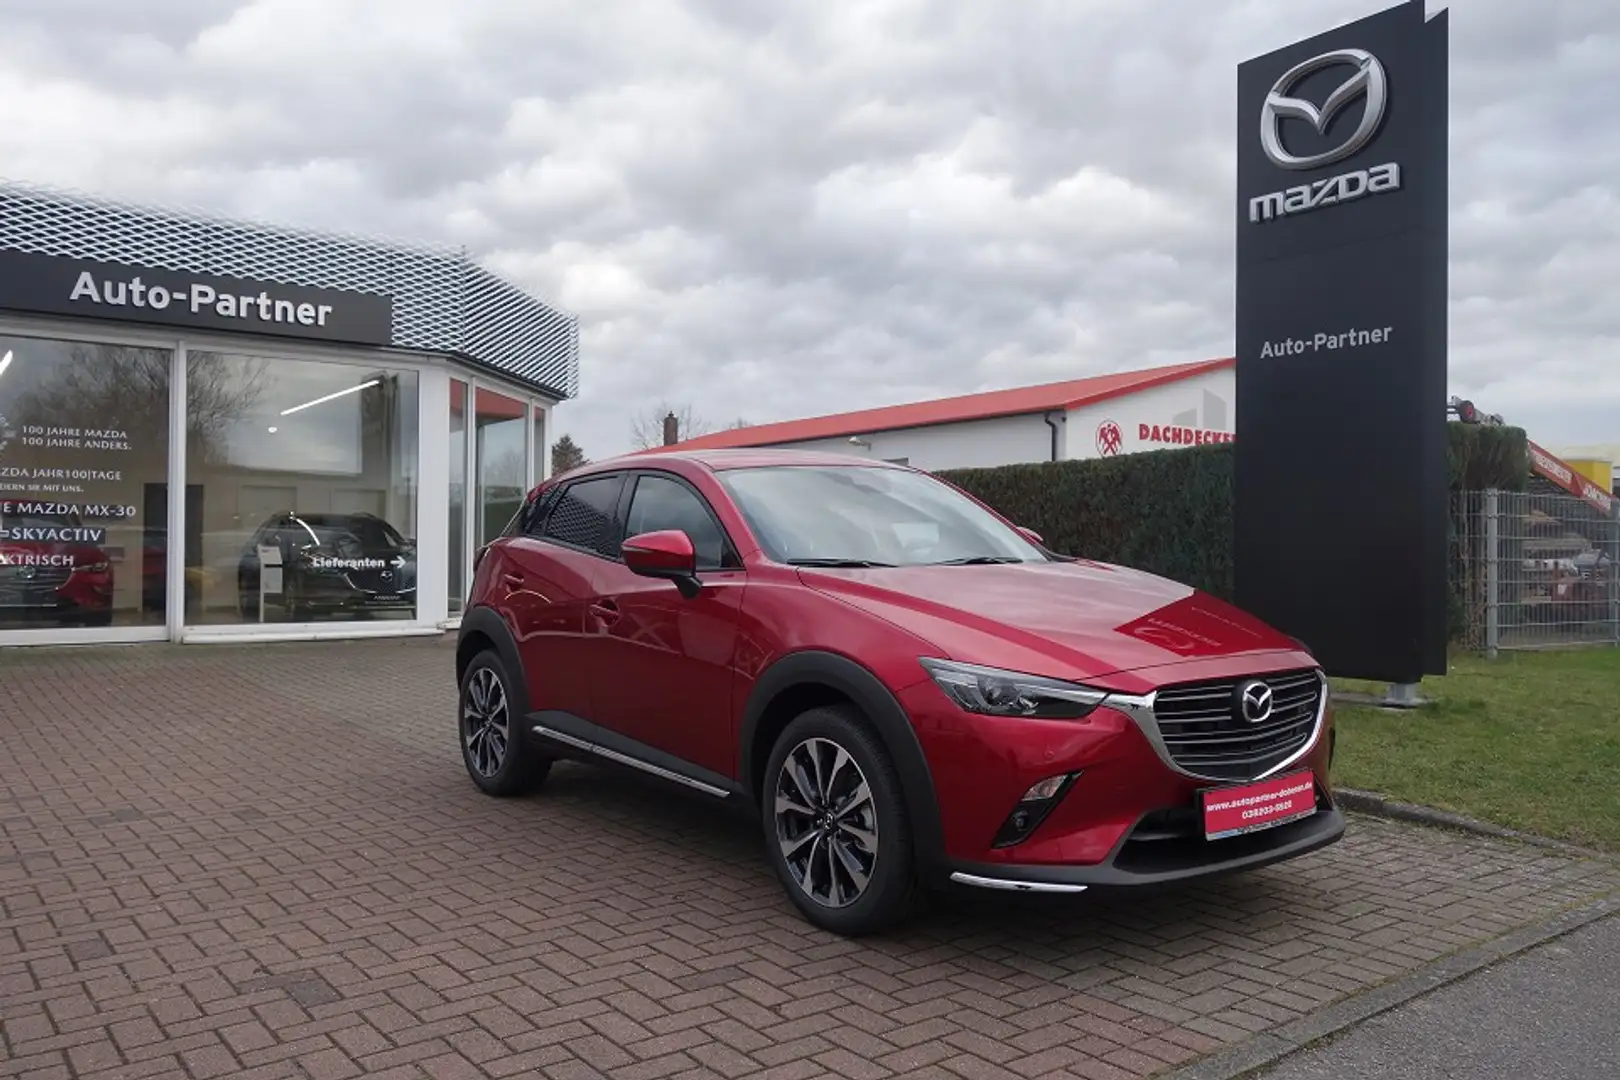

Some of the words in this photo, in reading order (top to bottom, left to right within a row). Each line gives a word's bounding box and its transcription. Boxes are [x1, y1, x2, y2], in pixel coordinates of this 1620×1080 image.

[70, 271, 333, 326] Auto-Partner
[1260, 326, 1393, 359] Auto-Partner
[22, 425, 44, 435] 100
[47, 427, 81, 437] JAHRE
[84, 428, 127, 439] MAZDA
[22, 437, 44, 447] 100
[47, 438, 81, 449] JAHRE
[84, 440, 132, 450] ANDERS.
[17, 503, 79, 515] MAZDA
[84, 505, 137, 517] MX-30
[313, 557, 385, 568] Lieferanten
